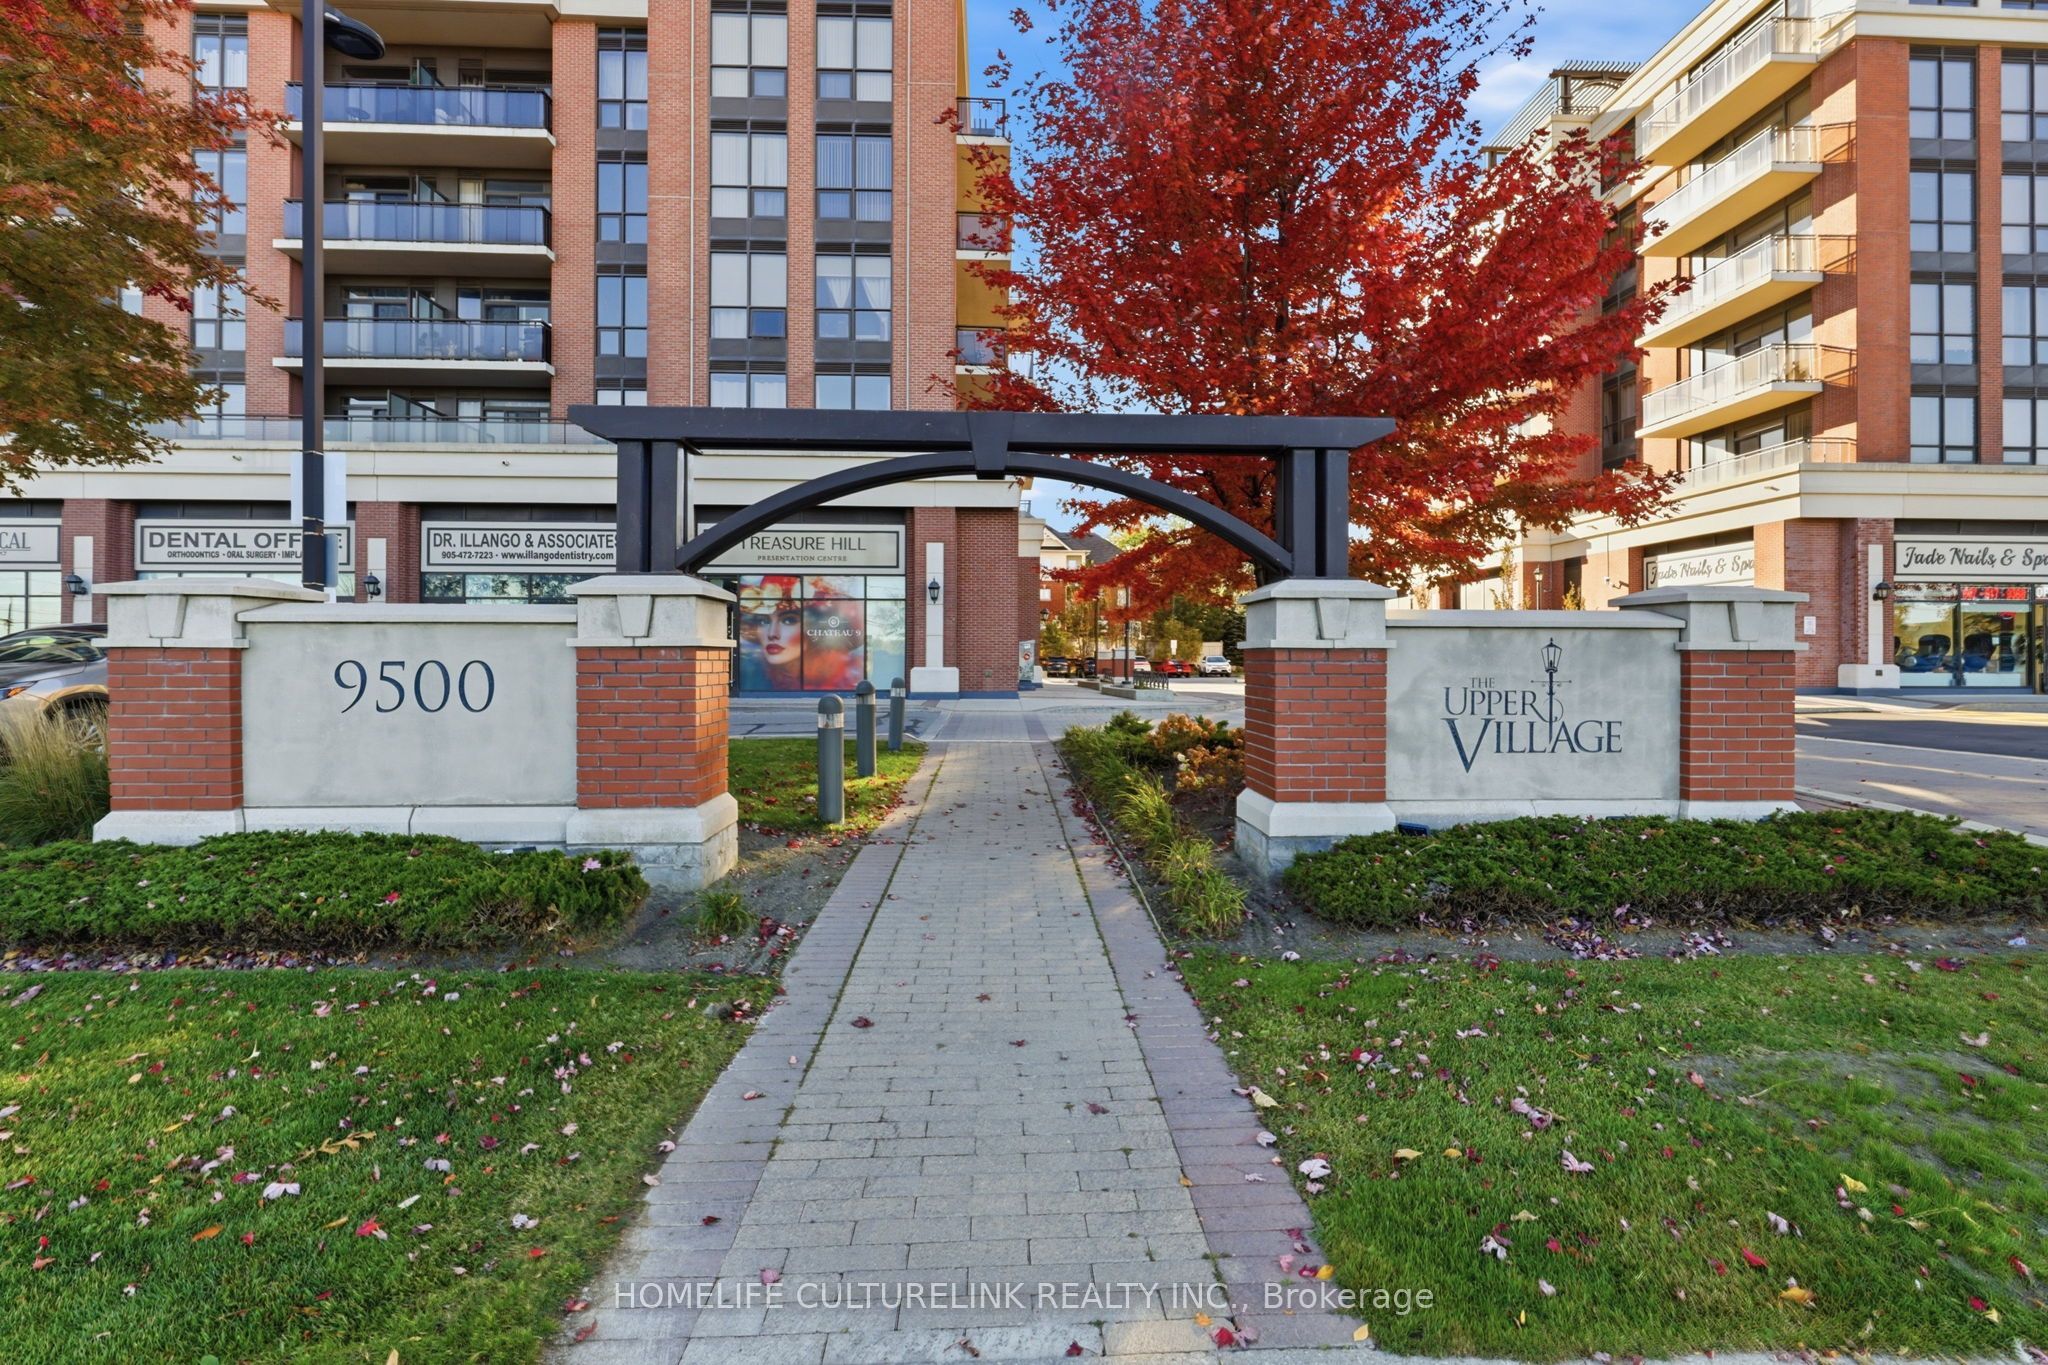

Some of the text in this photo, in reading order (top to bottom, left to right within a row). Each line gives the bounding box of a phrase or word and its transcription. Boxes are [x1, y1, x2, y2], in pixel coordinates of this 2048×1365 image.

[149, 532, 342, 549] DENTAL OFF
[433, 532, 456, 548] DR.
[460, 532, 521, 548] ILLANGO
[524, 532, 535, 549] &
[831, 537, 867, 551] HILL
[167, 550, 220, 560] ORTHODONTICS
[226, 551, 245, 560] ORAL
[245, 551, 277, 560] SURGERY
[441, 550, 614, 562] 905-472-7223 www.illangodentistry.com
[1903, 546, 1946, 568] Jade
[1949, 546, 1996, 568] Nails
[2000, 548, 2016, 567] &
[1679, 559, 1712, 578] Nails
[1715, 557, 1727, 574] &
[806, 629, 853, 637] CHATEAU
[334, 659, 495, 714] 9500
[1470, 677, 1496, 689] THE
[1444, 686, 1551, 723] UPPER
[1441, 717, 1623, 774] VILLAGE
